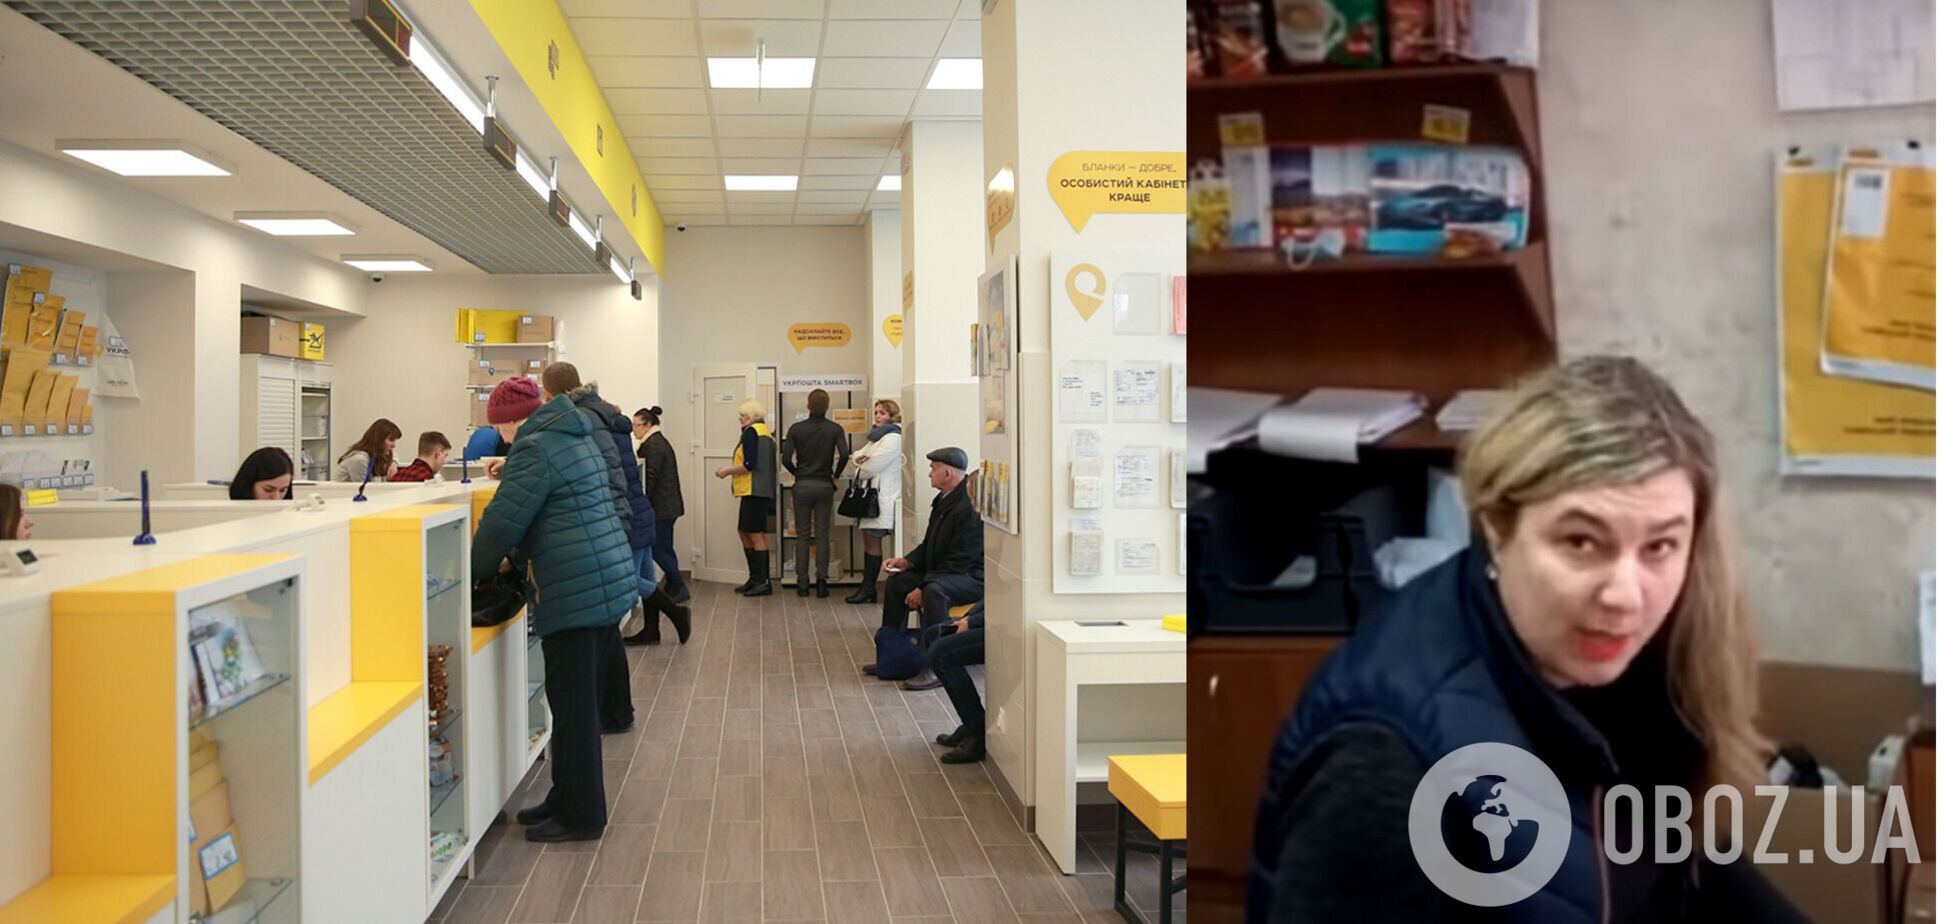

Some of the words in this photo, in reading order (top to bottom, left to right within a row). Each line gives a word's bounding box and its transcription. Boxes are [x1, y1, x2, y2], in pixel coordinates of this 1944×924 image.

[1082, 163, 1126, 172] БЛАНКИ
[1139, 163, 1177, 173] ДОБРЕ,
[1060, 177, 1134, 188] ОСОБИСТИЙ
[1137, 179, 1186, 189] КАБІНЕТ
[1109, 193, 1151, 203] КРАЩЕ
